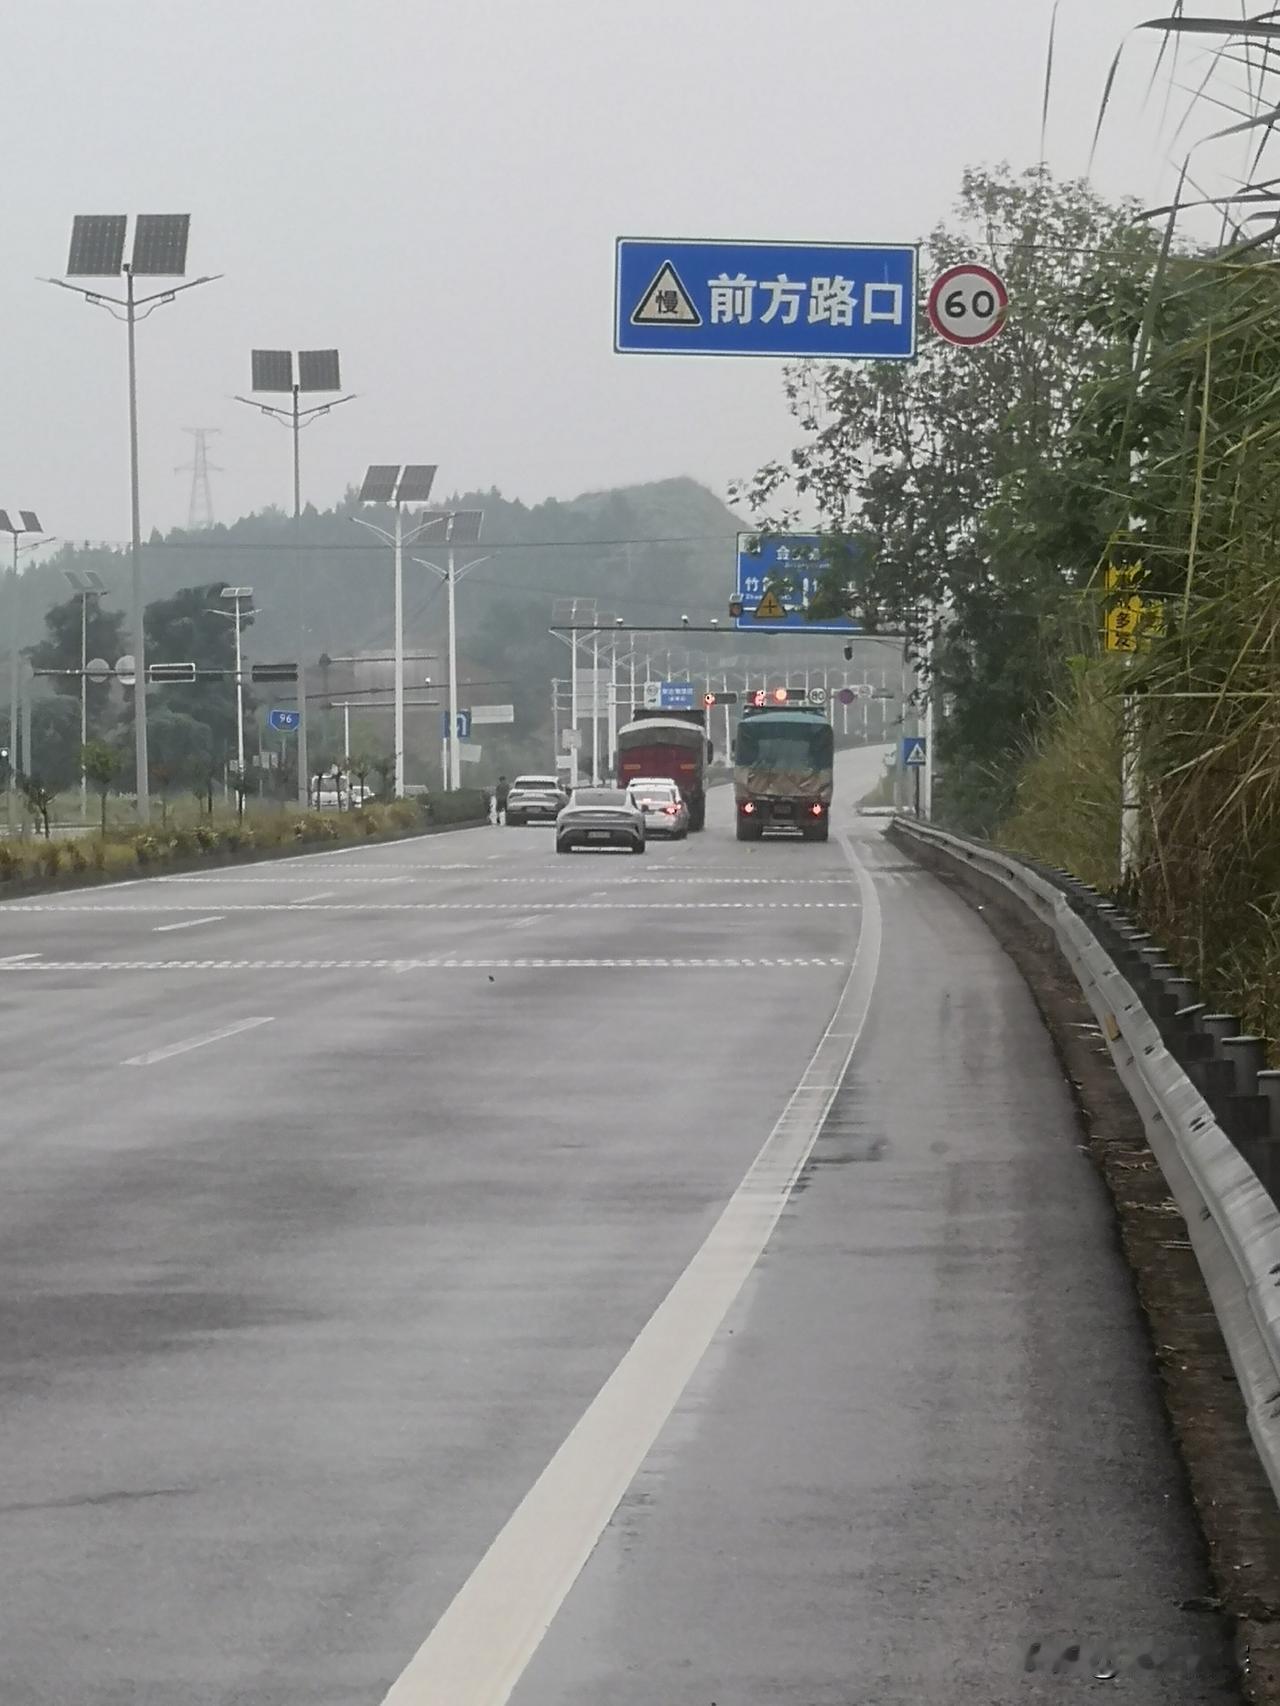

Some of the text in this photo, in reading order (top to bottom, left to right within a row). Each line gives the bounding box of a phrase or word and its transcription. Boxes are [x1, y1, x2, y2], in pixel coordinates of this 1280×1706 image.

[655, 289, 680, 315] 慢
[707, 273, 903, 326] 前方路口
[944, 289, 995, 319] 60
[279, 713, 293, 724] 96
